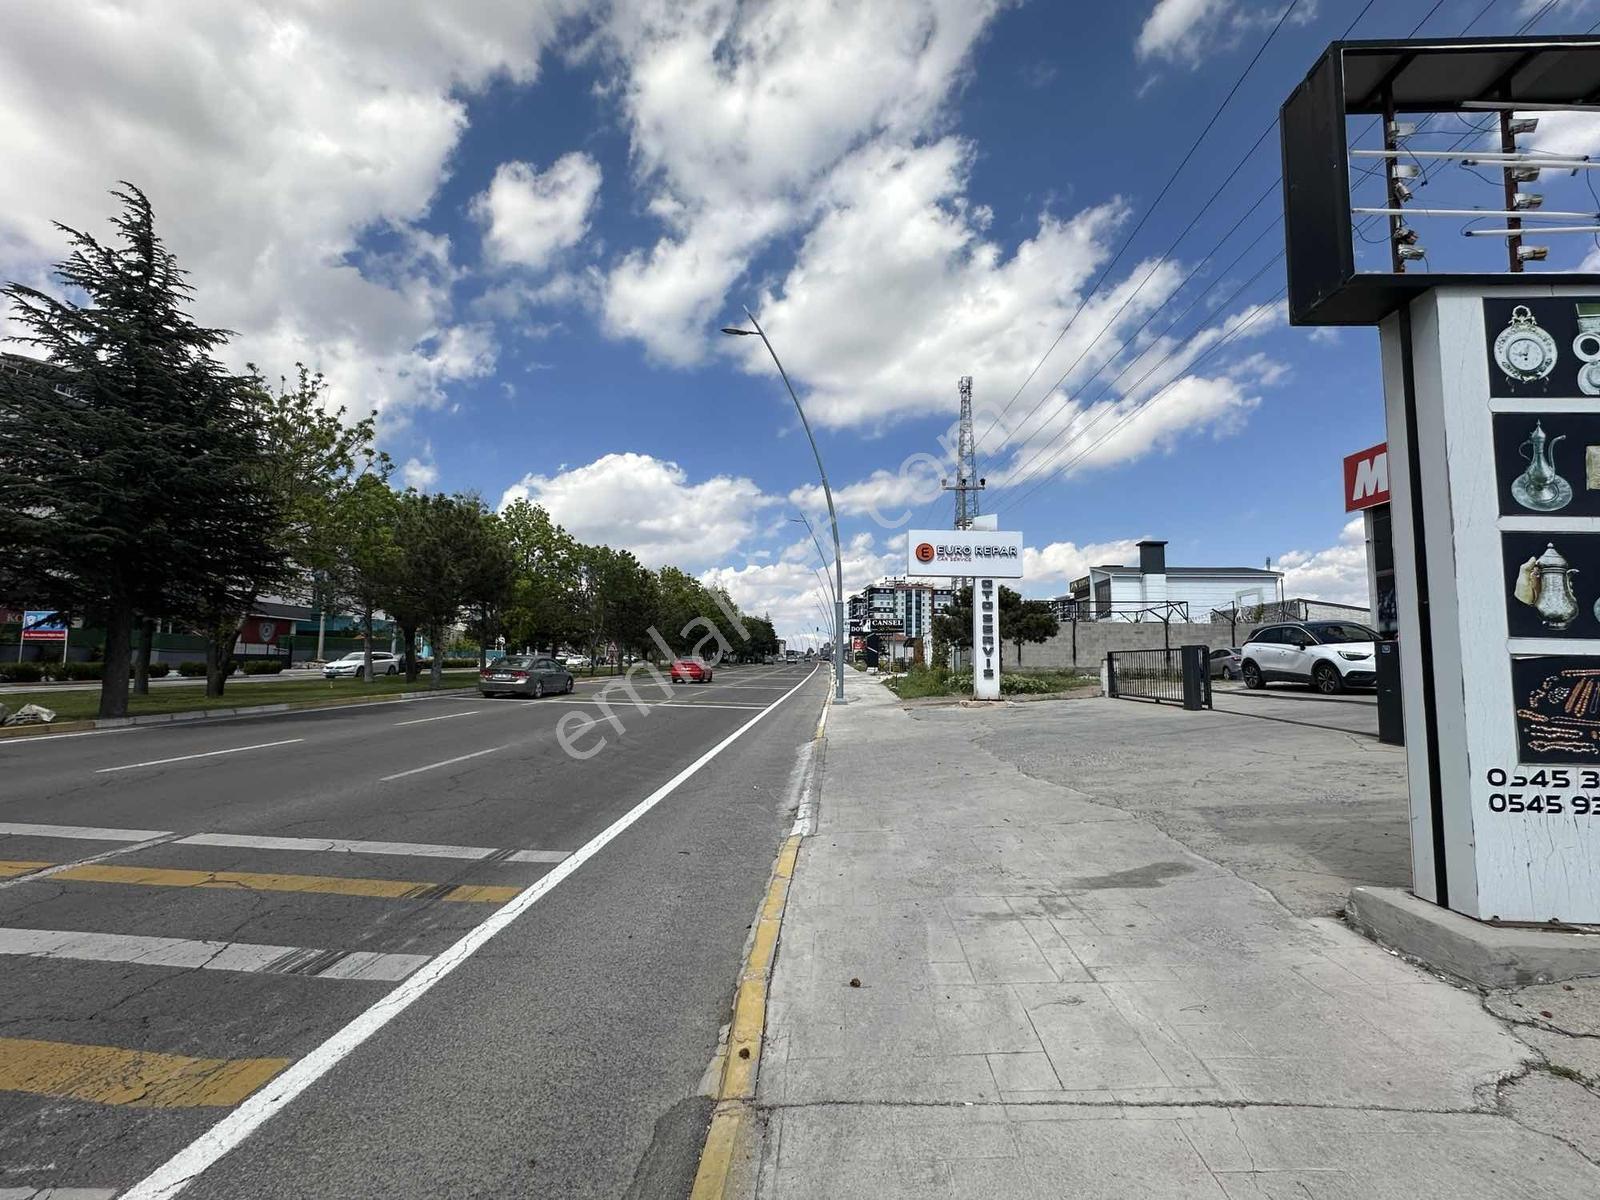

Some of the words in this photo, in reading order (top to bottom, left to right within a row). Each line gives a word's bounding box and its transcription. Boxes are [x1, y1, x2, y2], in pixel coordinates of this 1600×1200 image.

[936, 545, 972, 556] EURO
[975, 546, 1018, 558] REPAR
[1489, 793, 1563, 814] 0545
